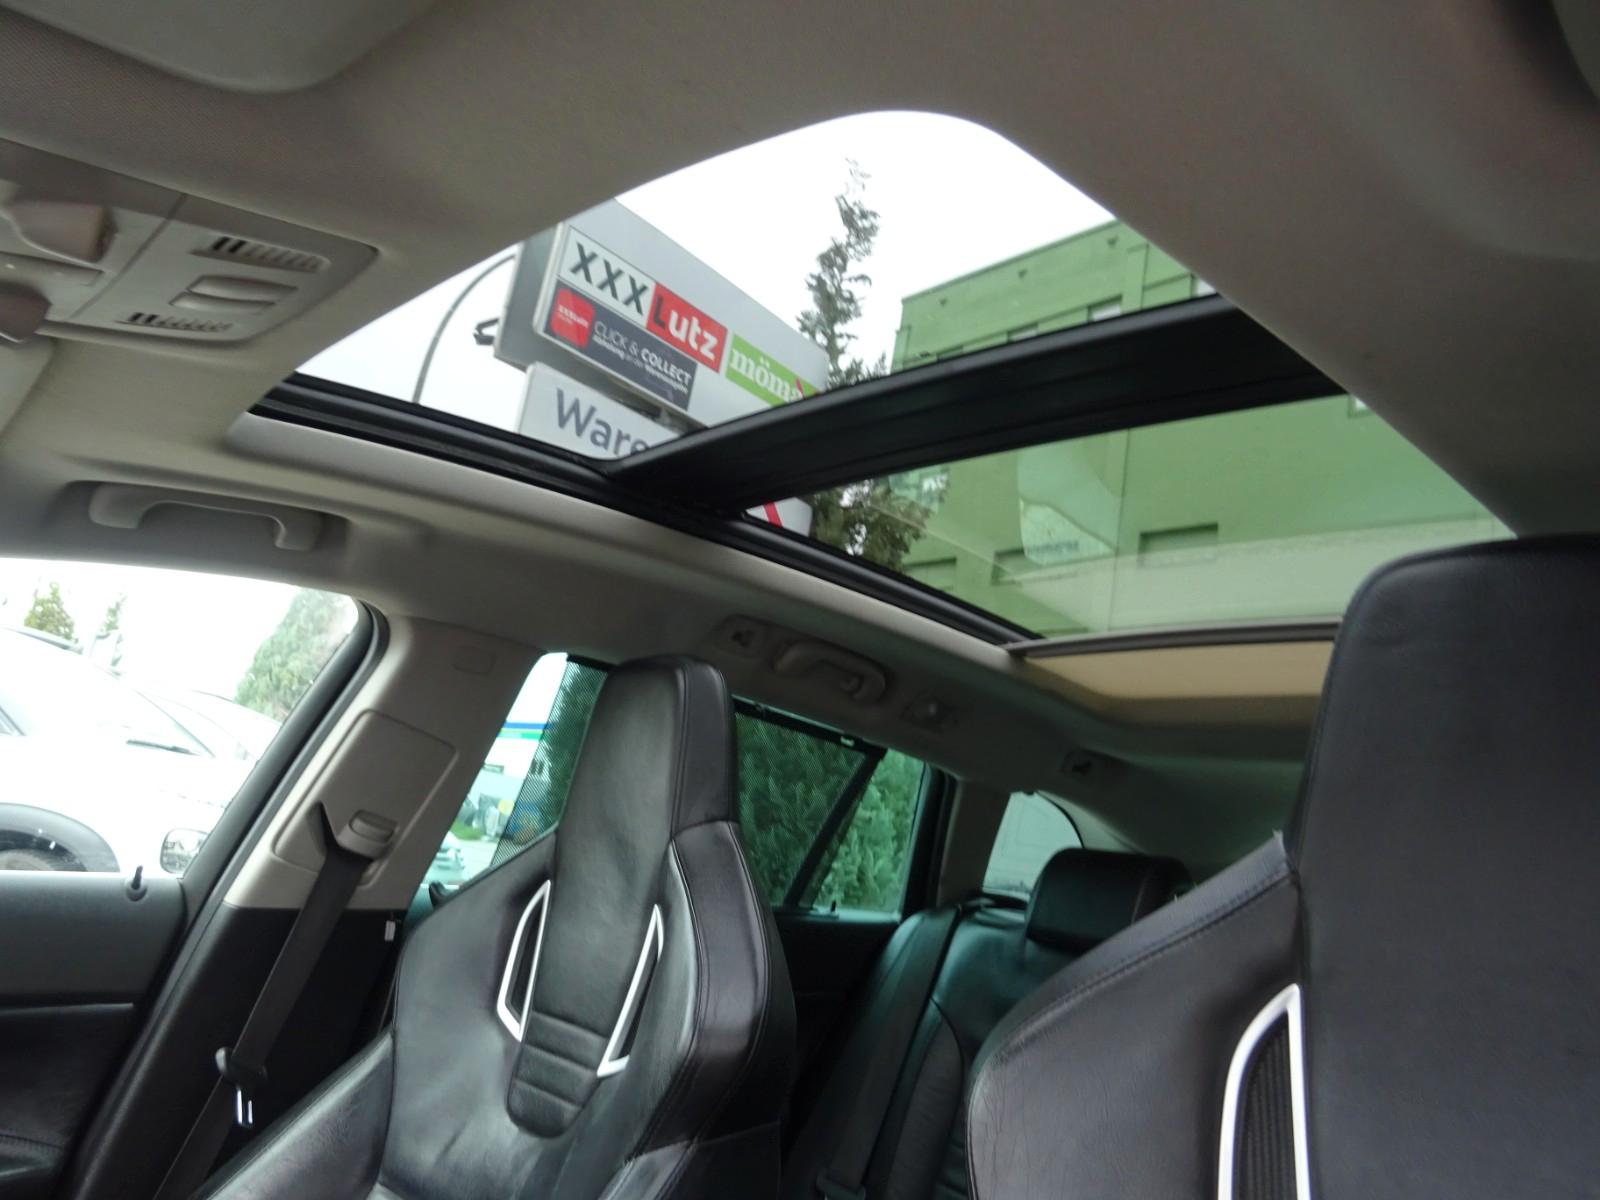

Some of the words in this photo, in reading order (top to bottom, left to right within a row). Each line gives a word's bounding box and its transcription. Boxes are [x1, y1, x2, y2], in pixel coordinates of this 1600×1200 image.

[594, 321, 628, 350] CLICK
[628, 340, 640, 357] &
[641, 348, 692, 387] COLLECT
